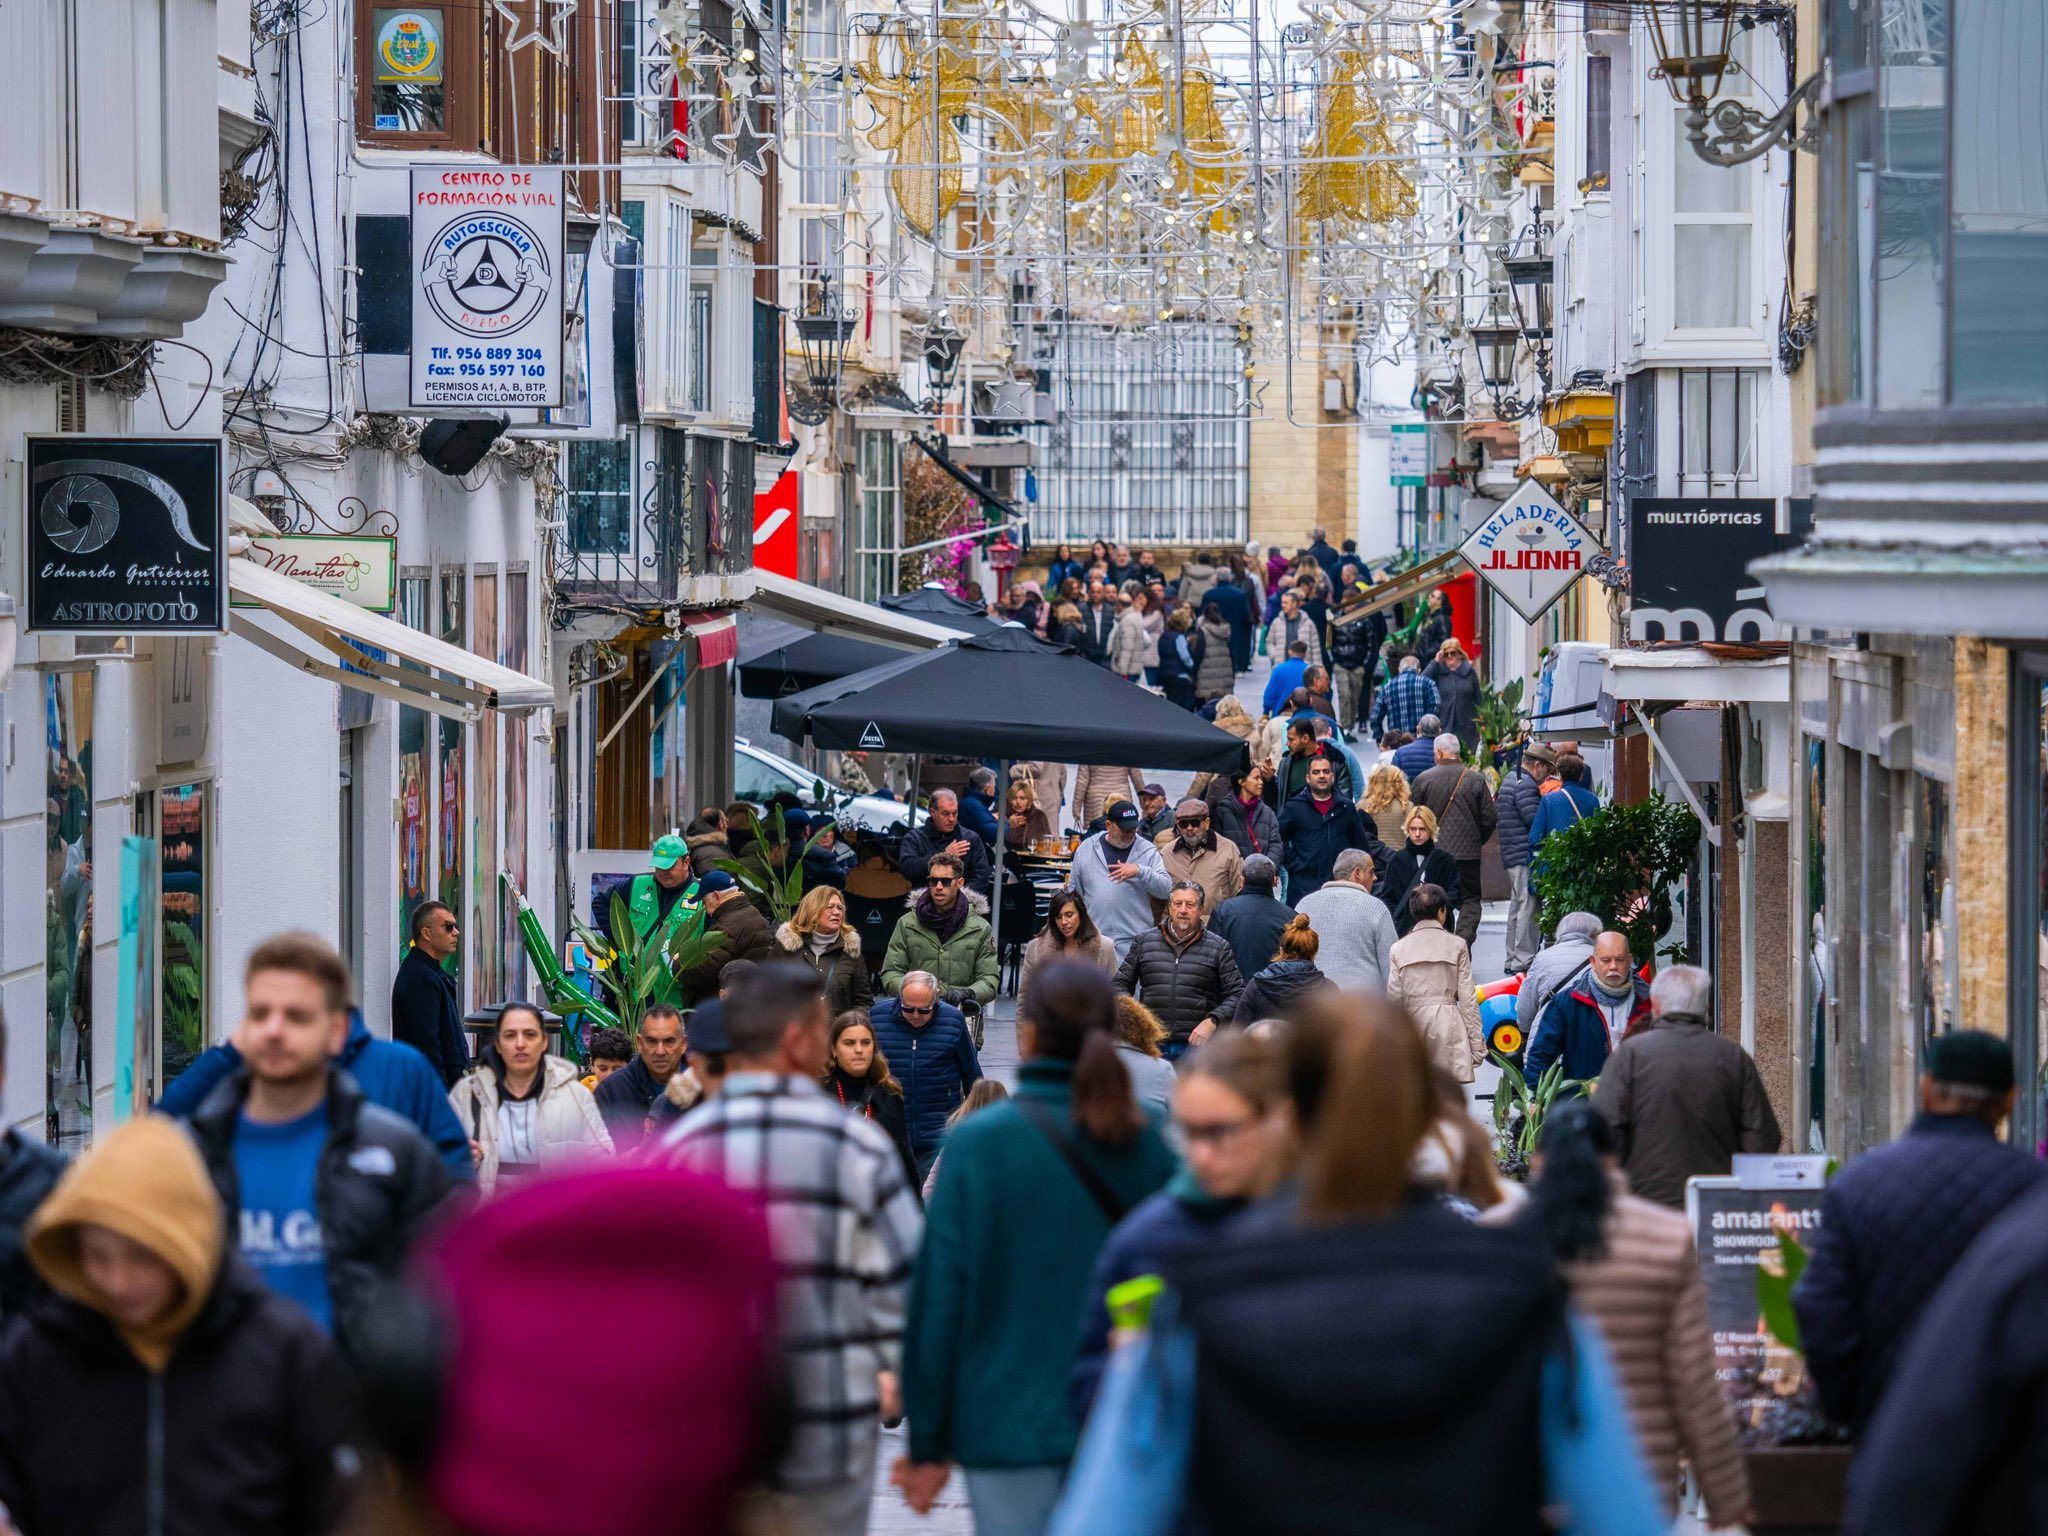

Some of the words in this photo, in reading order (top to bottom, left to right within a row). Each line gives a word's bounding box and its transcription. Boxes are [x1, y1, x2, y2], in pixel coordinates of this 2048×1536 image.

[442, 172, 505, 186] CENTRO
[511, 172, 532, 186] DE
[418, 188, 517, 206] FORMACIÓN
[522, 192, 556, 206] VIAL
[444, 221, 532, 253] AUTOESCUELA
[456, 347, 482, 360] 956
[486, 347, 512, 360] 889
[516, 348, 542, 361] 304
[428, 363, 455, 376] Fax:
[459, 364, 485, 376] 956
[489, 364, 515, 377] 597
[520, 364, 545, 377] 160
[425, 382, 479, 391] PERMISOS
[499, 382, 510, 392] A,
[512, 383, 523, 392] B,
[525, 383, 547, 393] BTP,
[426, 392, 474, 401] LICENCIA
[477, 392, 546, 402] CICLOMOTOR
[1479, 504, 1582, 551] HELADERIA
[1481, 550, 1581, 570] JIJONA
[41, 562, 117, 579] Eduardo
[52, 602, 199, 621] ASTROFOTO
[1771, 1161, 1811, 1170] ABIERTO
